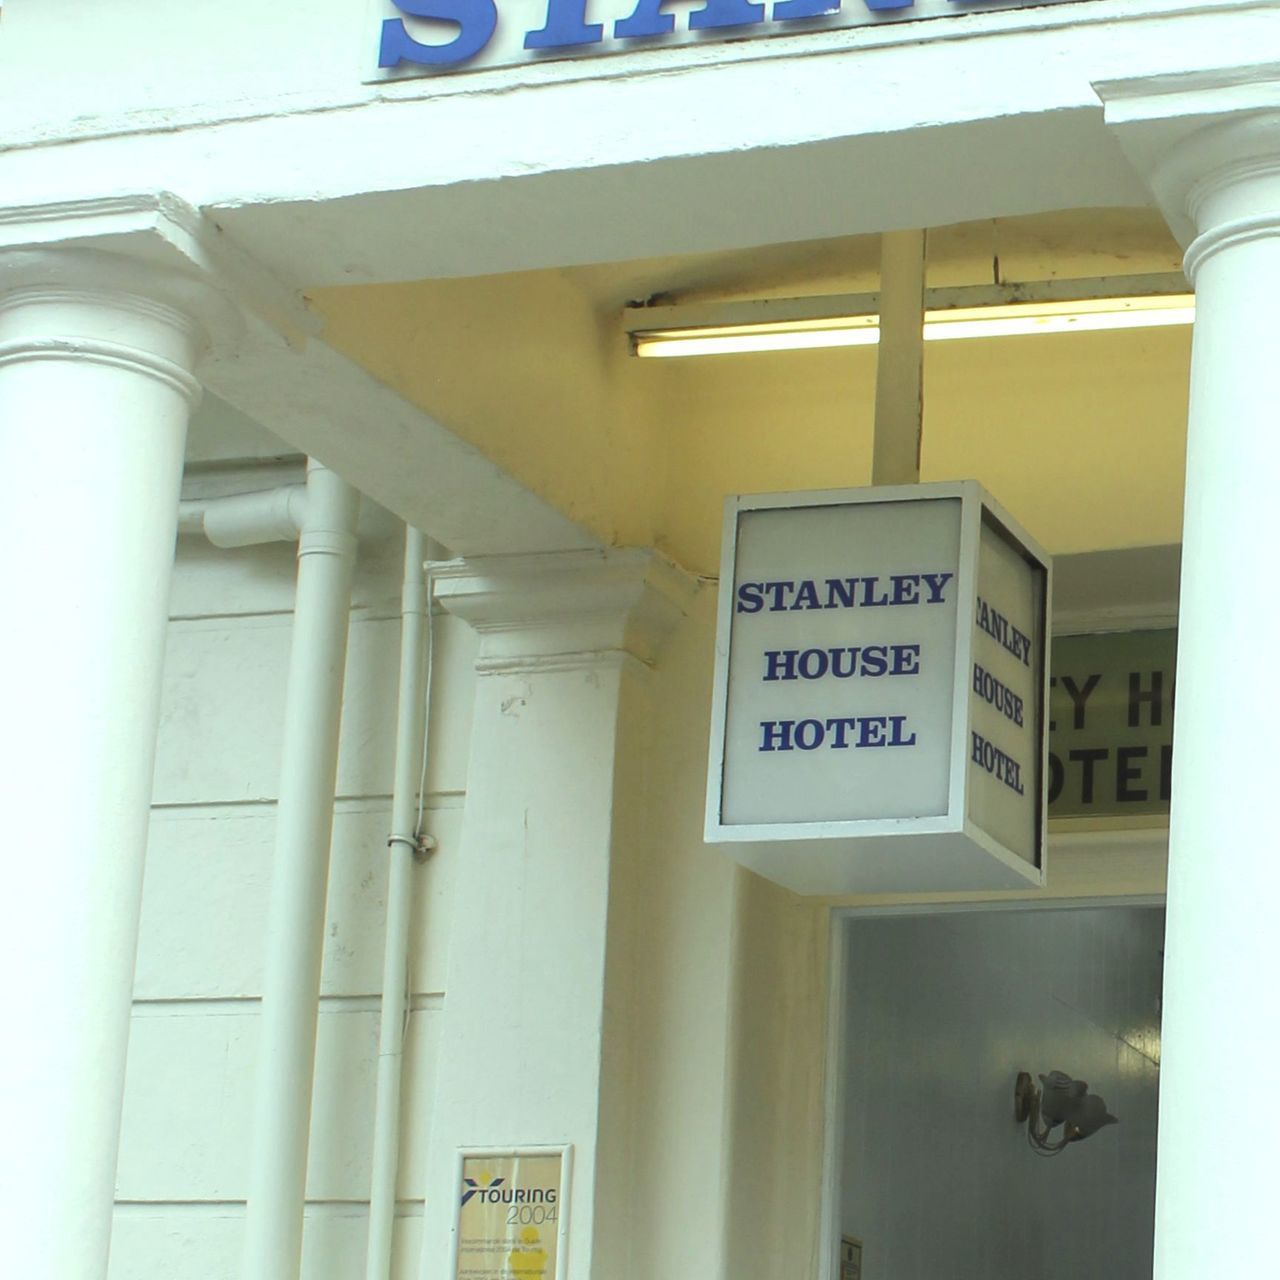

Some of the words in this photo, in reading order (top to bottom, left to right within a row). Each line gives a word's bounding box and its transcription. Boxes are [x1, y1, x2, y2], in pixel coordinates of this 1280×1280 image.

[736, 573, 954, 614] STANLEY
[762, 644, 921, 681] HOUSE
[972, 663, 1024, 728] HOUSE
[758, 716, 917, 752] HOTEL
[971, 731, 1025, 796] HOTEL
[479, 1188, 557, 1204] TOURING
[506, 1205, 558, 1225] 2004
